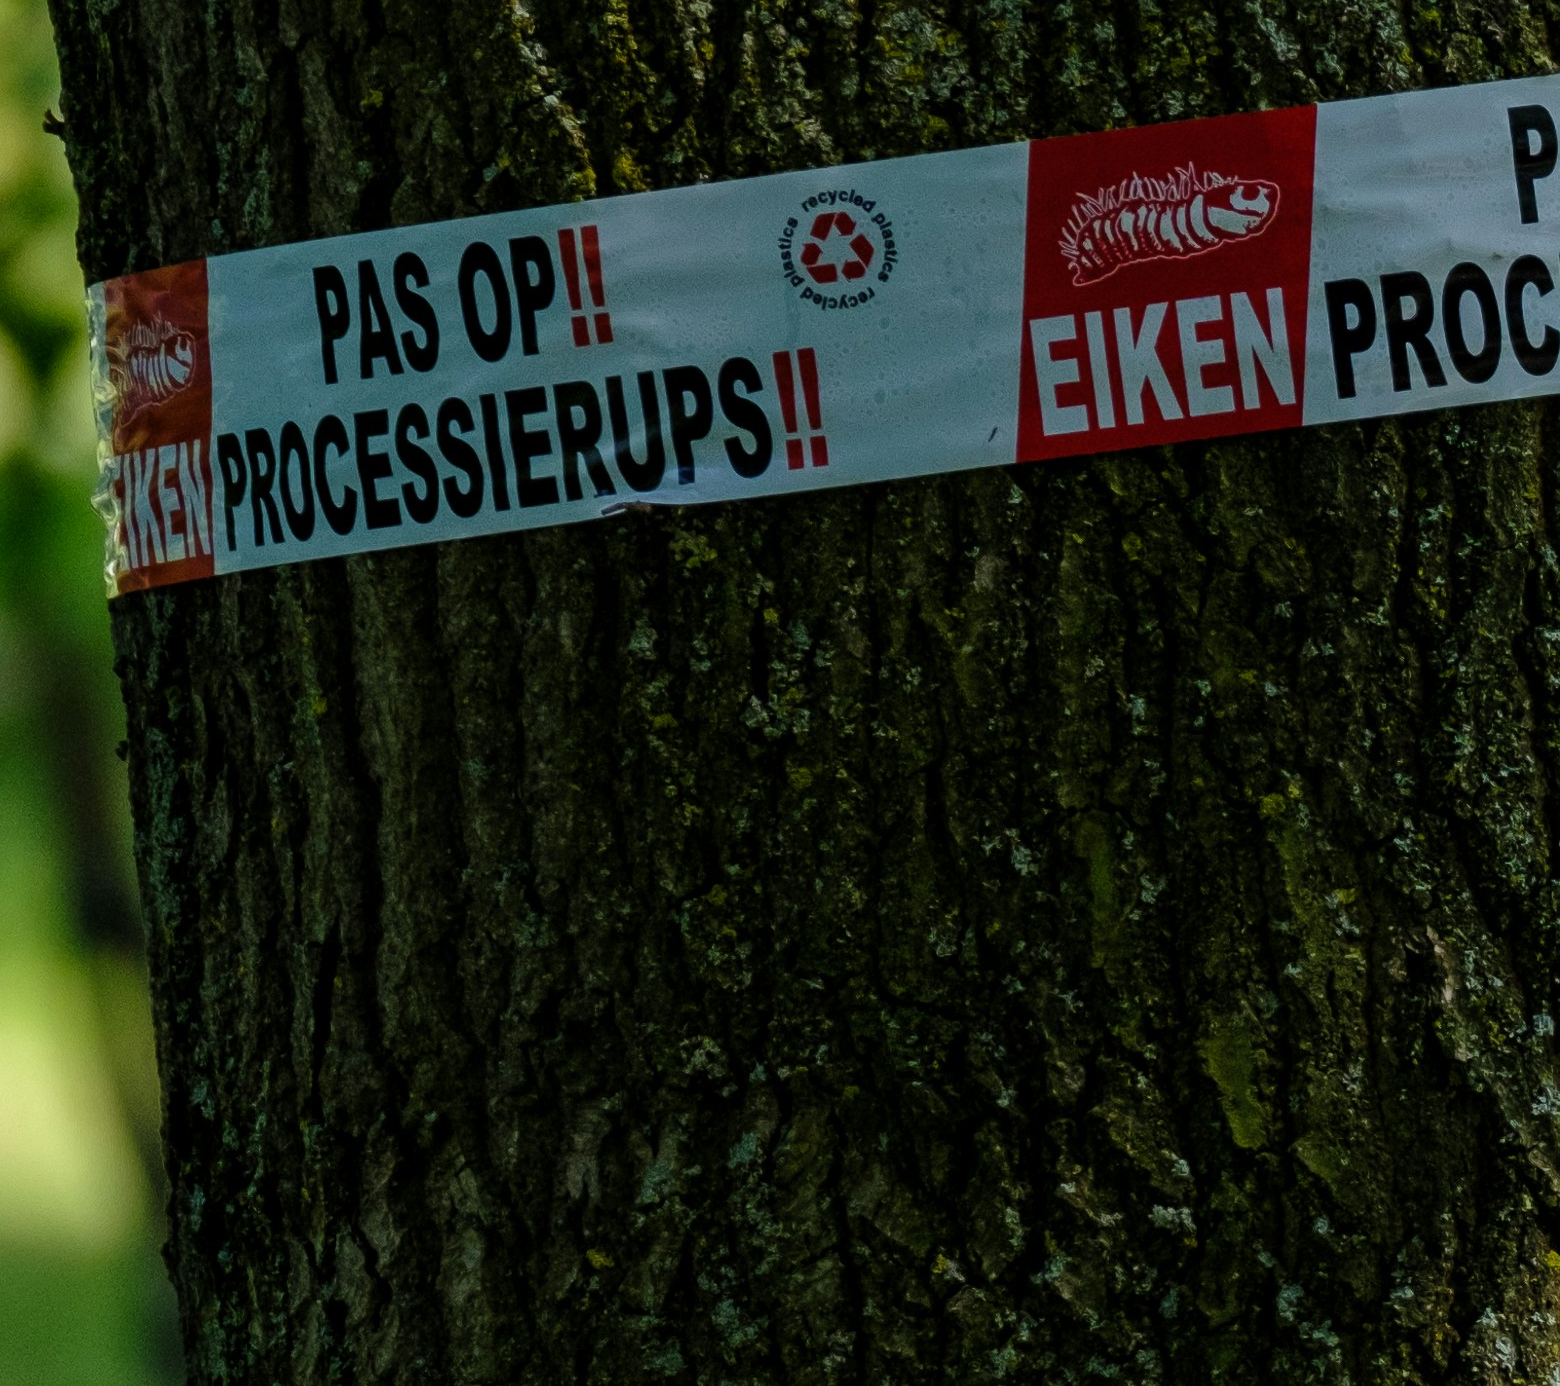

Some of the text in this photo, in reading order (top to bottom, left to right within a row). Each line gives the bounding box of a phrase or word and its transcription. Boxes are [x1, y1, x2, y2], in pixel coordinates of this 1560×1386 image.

[311, 225, 614, 385] PAS OP!!
[778, 217, 876, 311] recycled plastics
[801, 189, 898, 282] recycled plastics
[1029, 287, 1297, 437] EIKEN
[216, 347, 829, 553] PROCESSIERUPS!!
